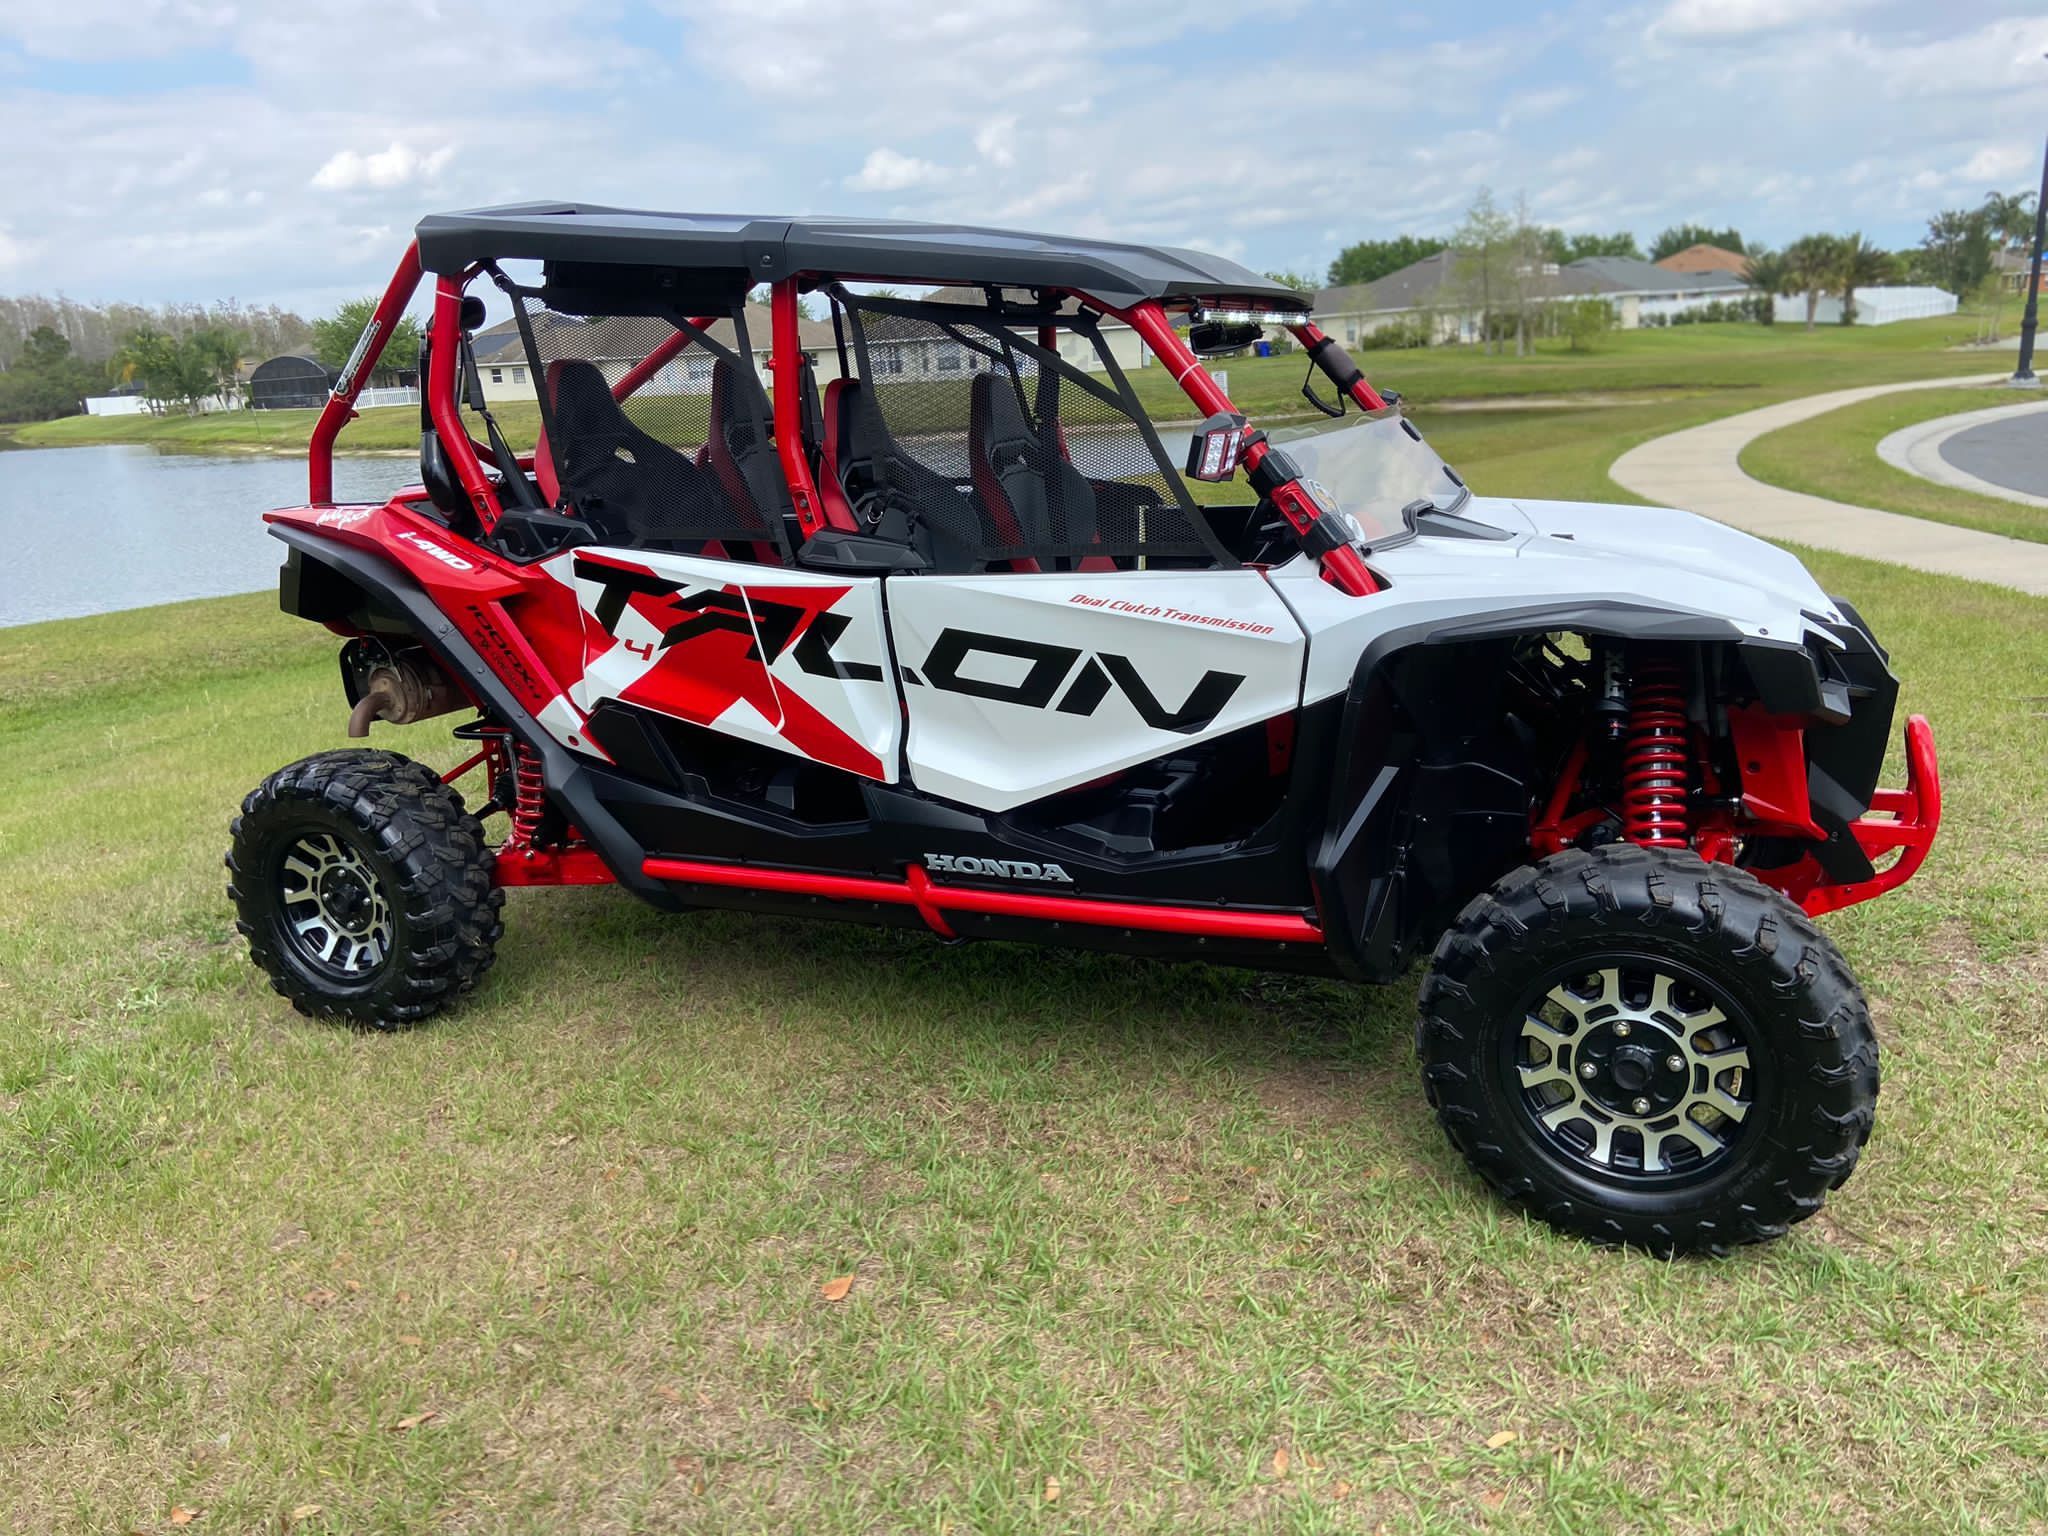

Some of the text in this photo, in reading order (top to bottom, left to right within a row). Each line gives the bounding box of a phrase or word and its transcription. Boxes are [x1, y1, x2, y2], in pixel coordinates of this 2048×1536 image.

[1069, 593, 1275, 635] Dual Clutch Transmission
[574, 558, 1247, 735] TALON
[923, 852, 1075, 883] HONDA
